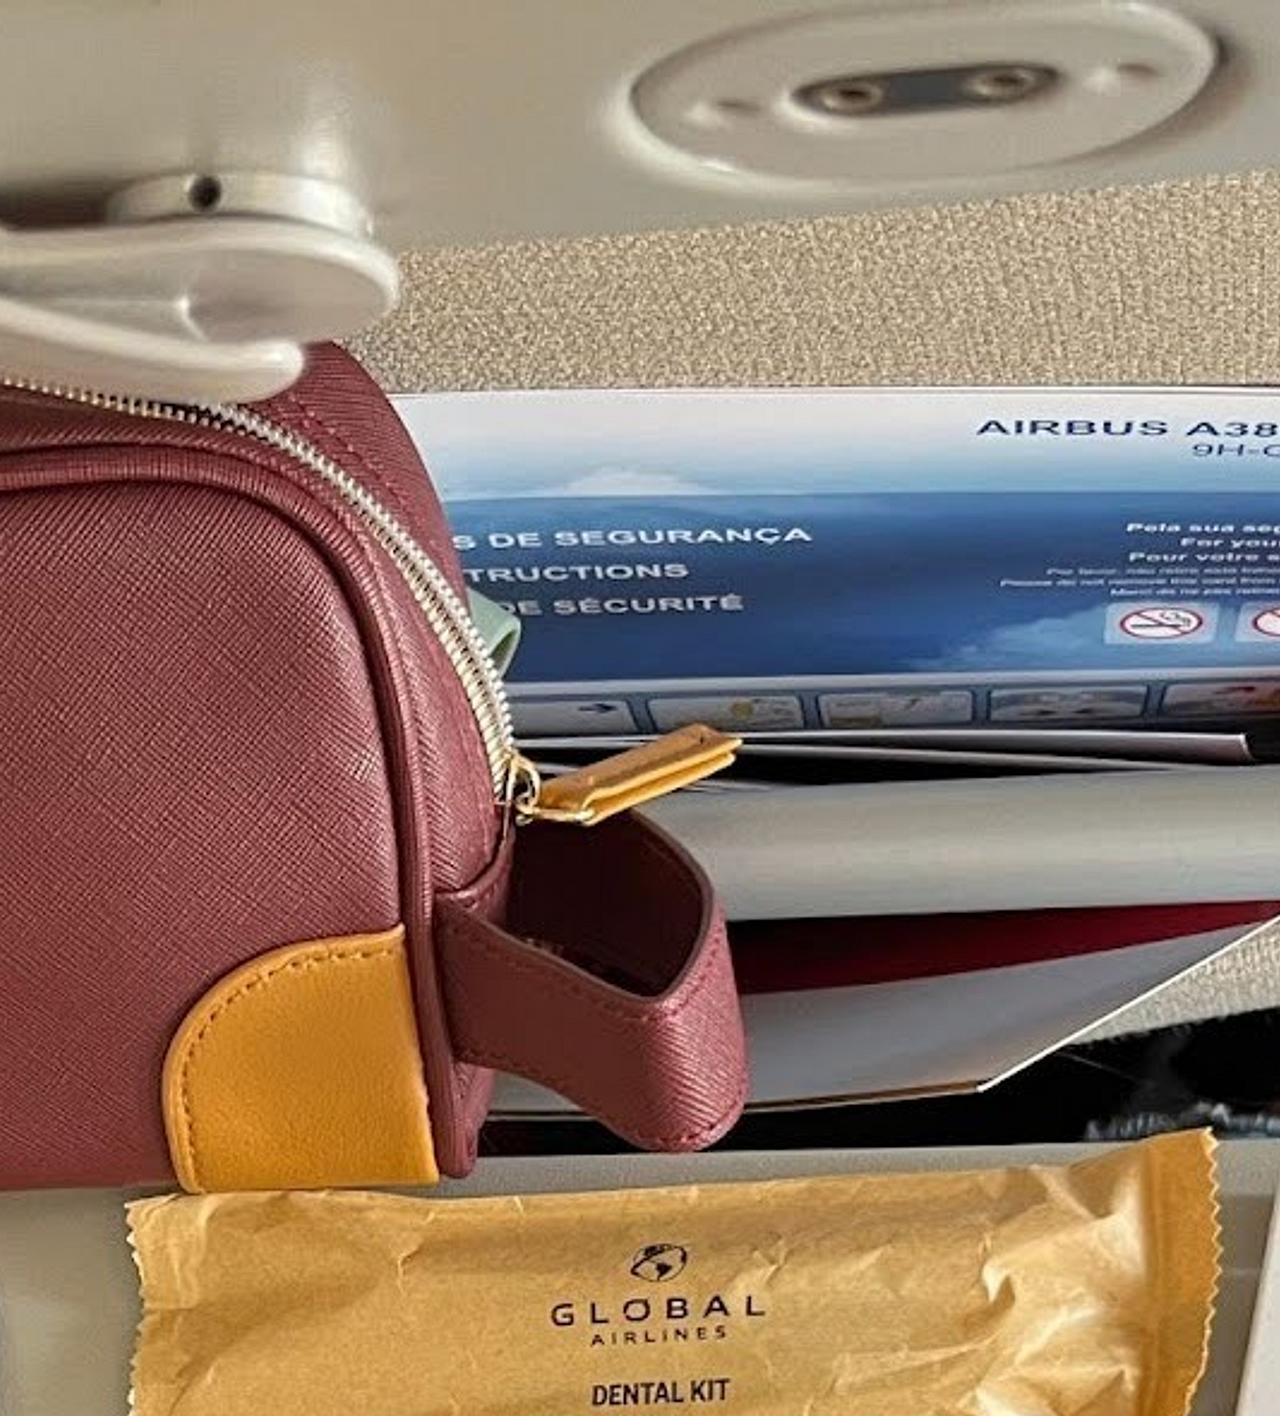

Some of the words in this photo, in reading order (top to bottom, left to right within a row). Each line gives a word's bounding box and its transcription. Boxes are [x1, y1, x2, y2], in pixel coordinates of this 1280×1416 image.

[975, 419, 1169, 437] AIRBUS
[1126, 522, 1181, 534] Pela
[1188, 524, 1235, 534] sua
[451, 534, 476, 550] S
[488, 532, 543, 549] DE
[554, 527, 813, 547] SEGURANÇA
[1180, 537, 1224, 548] For
[1128, 552, 1188, 563] Pour
[1195, 552, 1260, 562] votre
[462, 564, 690, 583] TRUCTIONS
[553, 593, 745, 615] SÉCURITÉ
[549, 1295, 766, 1327] GLOBAL
[589, 1325, 728, 1347] AIRLINES
[591, 1382, 686, 1407] DENTAL
[690, 1377, 731, 1402] KIT
